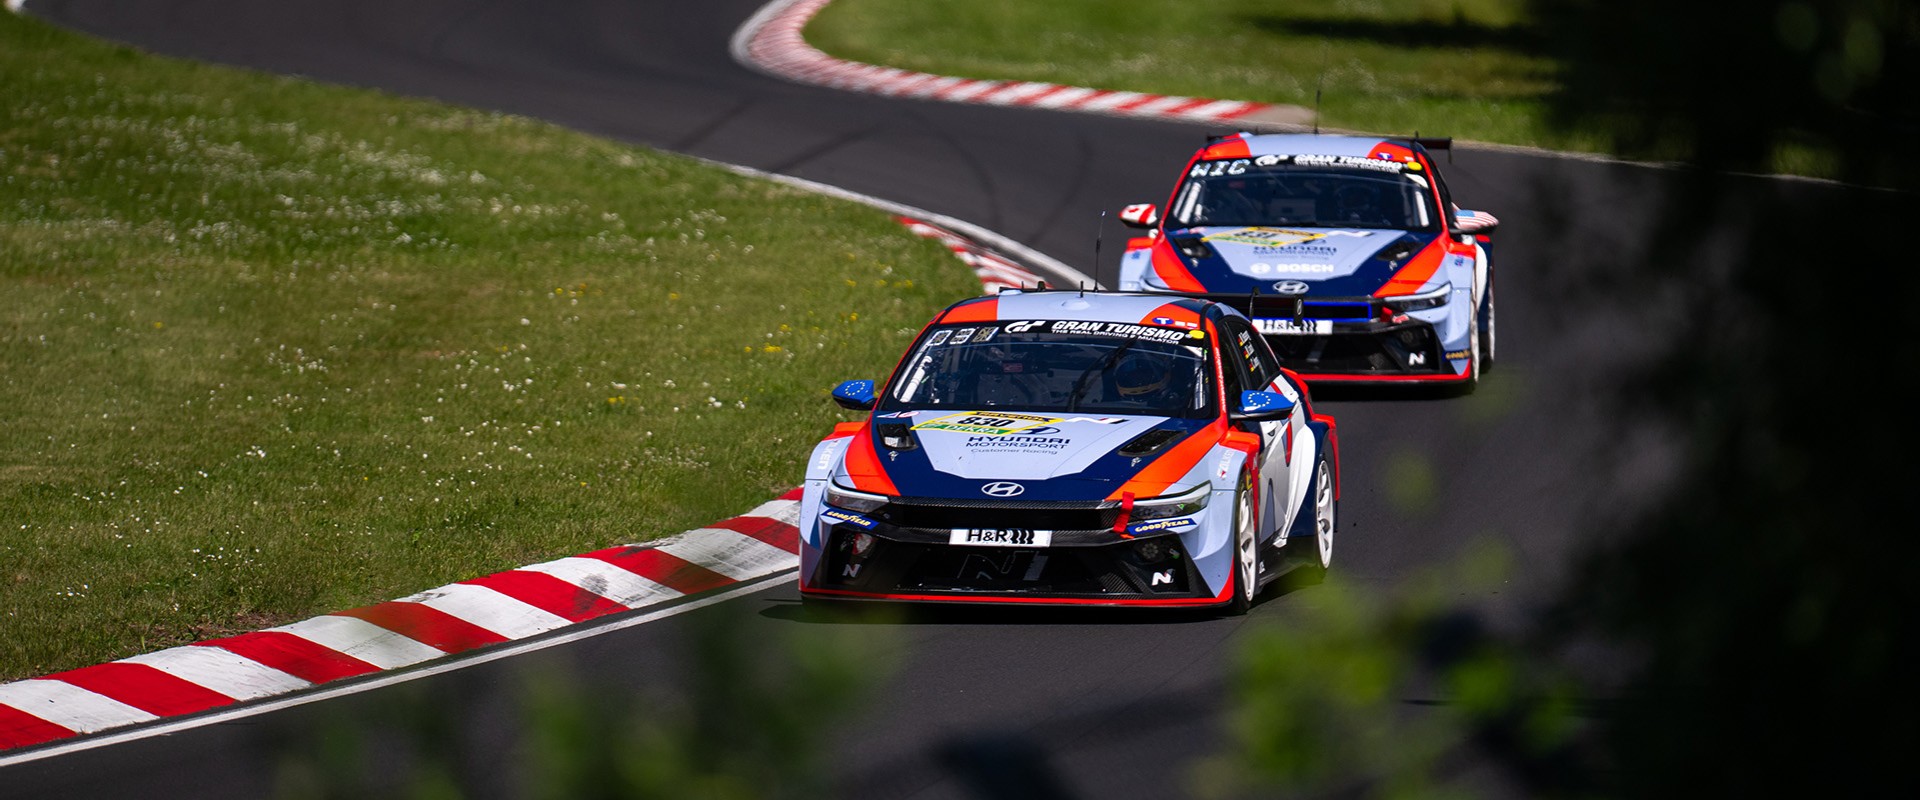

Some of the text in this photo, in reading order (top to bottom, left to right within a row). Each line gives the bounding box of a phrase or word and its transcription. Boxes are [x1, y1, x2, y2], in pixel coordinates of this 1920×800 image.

[1277, 263, 1334, 273] BOSCH
[1051, 320, 1187, 341] GRAN TURISMO
[1095, 331, 1129, 339] DRIVING
[1130, 334, 1179, 345] SMULATOR
[957, 416, 1016, 427] 830
[968, 436, 1071, 444] HYUNDAI
[826, 510, 872, 527] GOODYEAR
[1134, 519, 1190, 533] GOODYEAR
[967, 528, 1009, 542] H&R
